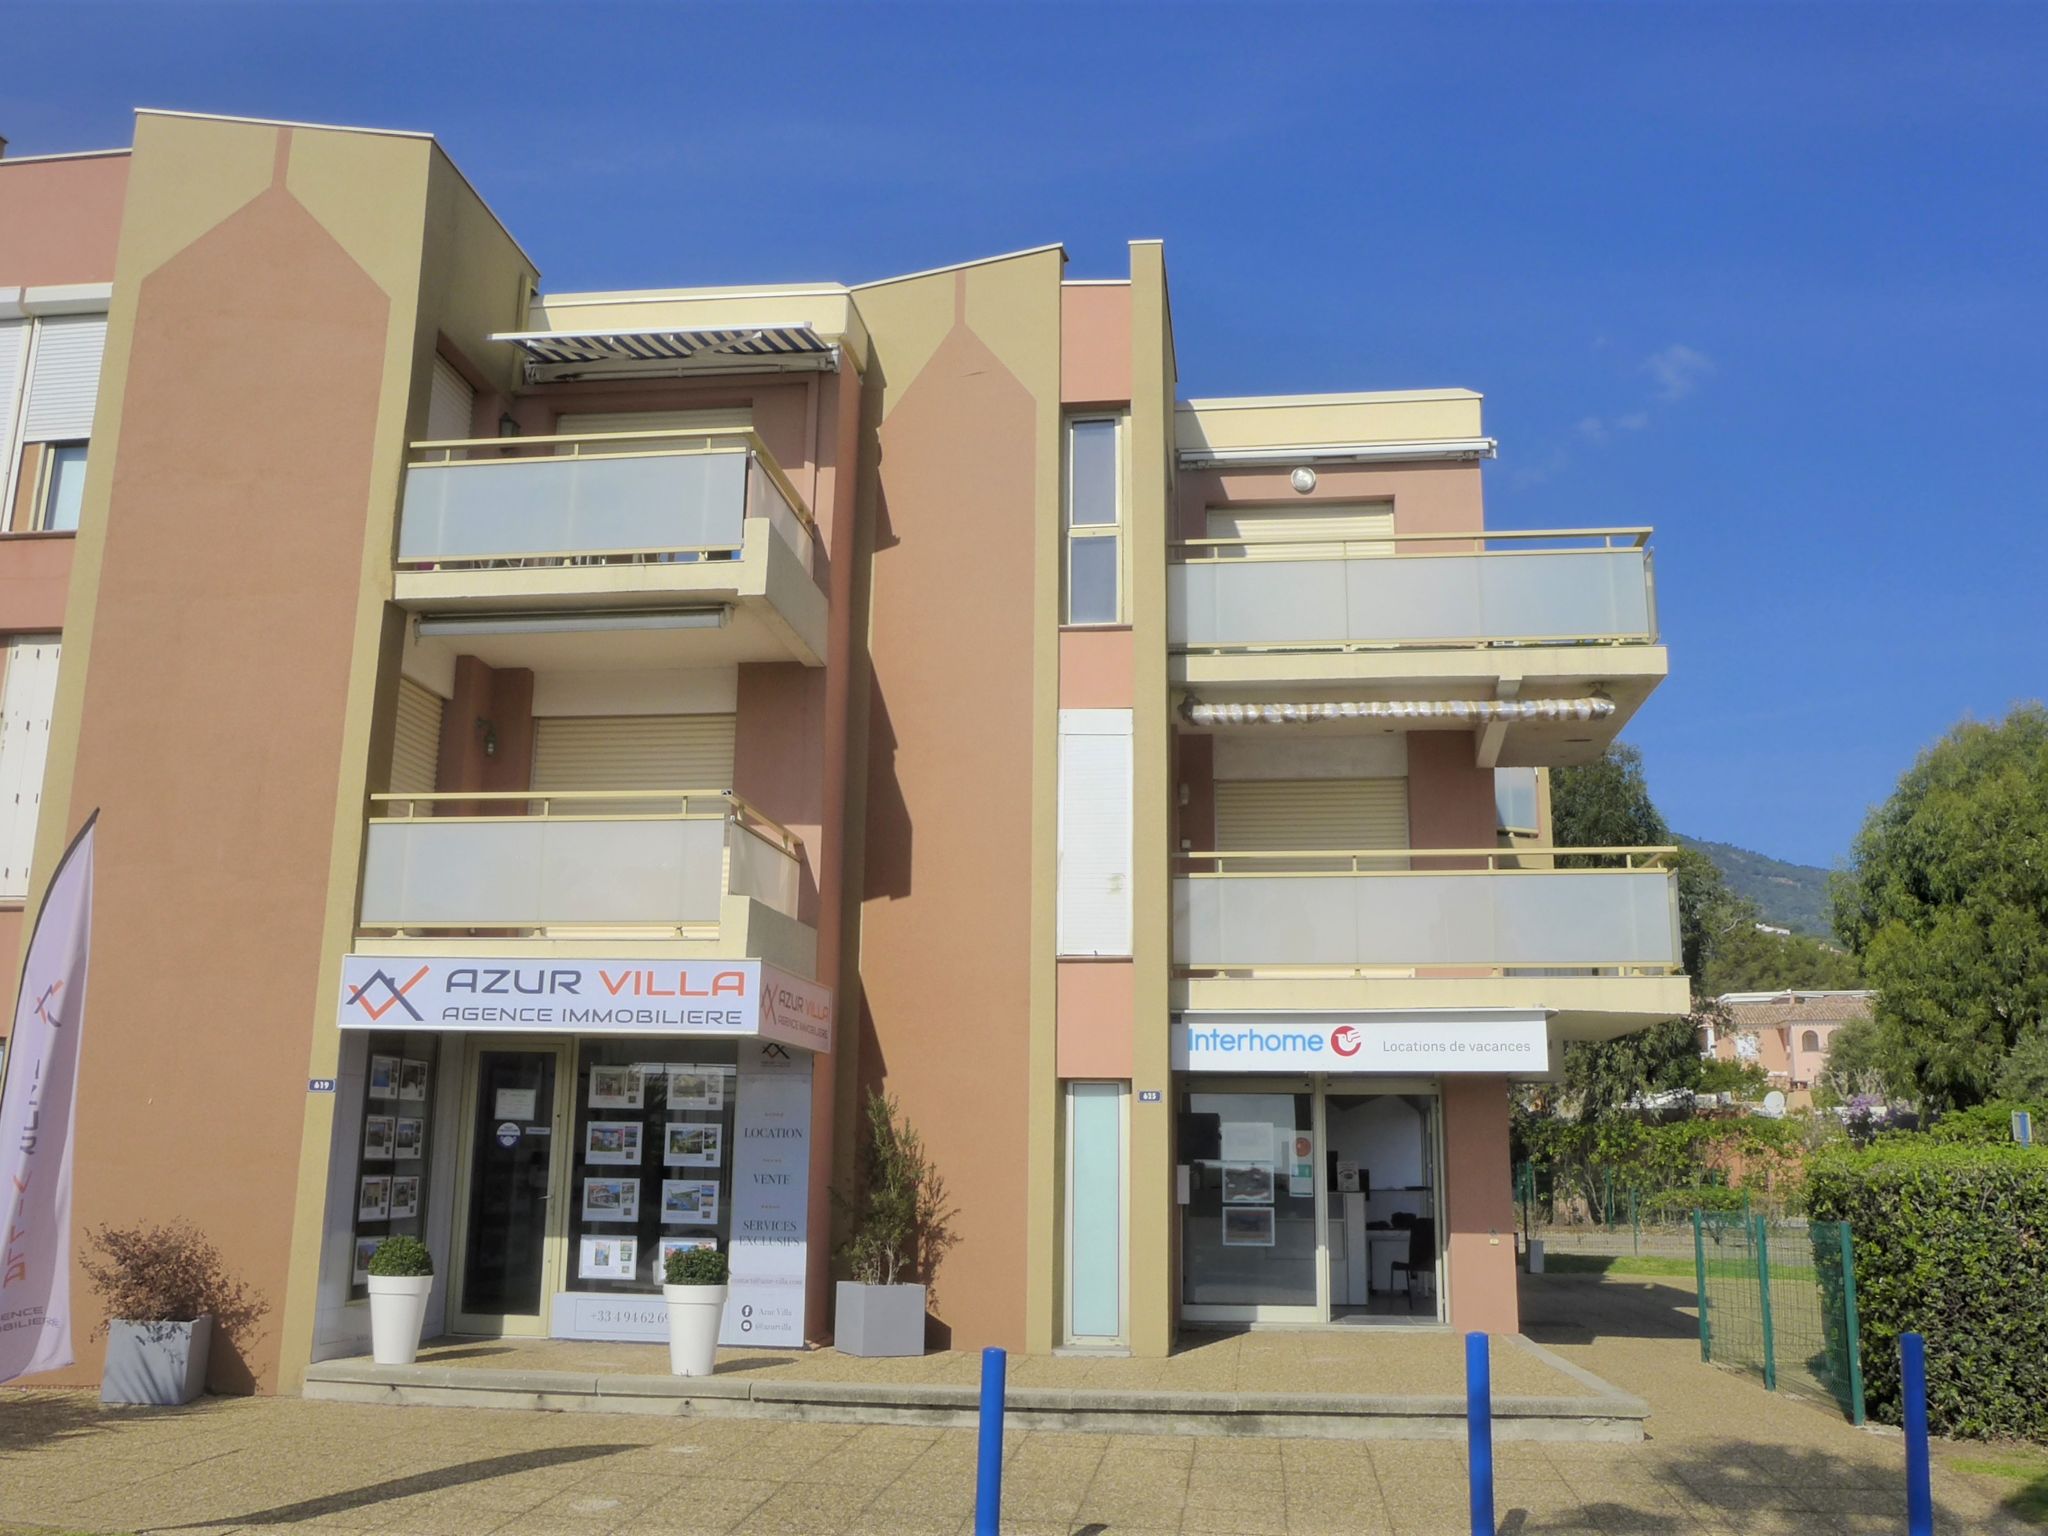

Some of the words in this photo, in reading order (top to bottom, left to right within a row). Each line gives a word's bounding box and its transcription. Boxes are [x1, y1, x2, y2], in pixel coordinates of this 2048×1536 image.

[446, 969, 582, 995] AZUR
[598, 970, 745, 997] VILLA
[779, 989, 804, 1013] AZUR
[442, 1007, 553, 1022] AGENCE
[562, 1009, 742, 1025] IMMOBILIERE
[1186, 1028, 1324, 1052] Interhome
[1383, 1041, 1446, 1052] Locations
[1449, 1041, 1465, 1052] de
[1469, 1043, 1531, 1052] vacances
[744, 1127, 803, 1138] LOCATION
[753, 1174, 791, 1185] VENTE
[743, 1219, 798, 1231] SERVICES
[739, 1235, 800, 1247] EXCLUSIFS
